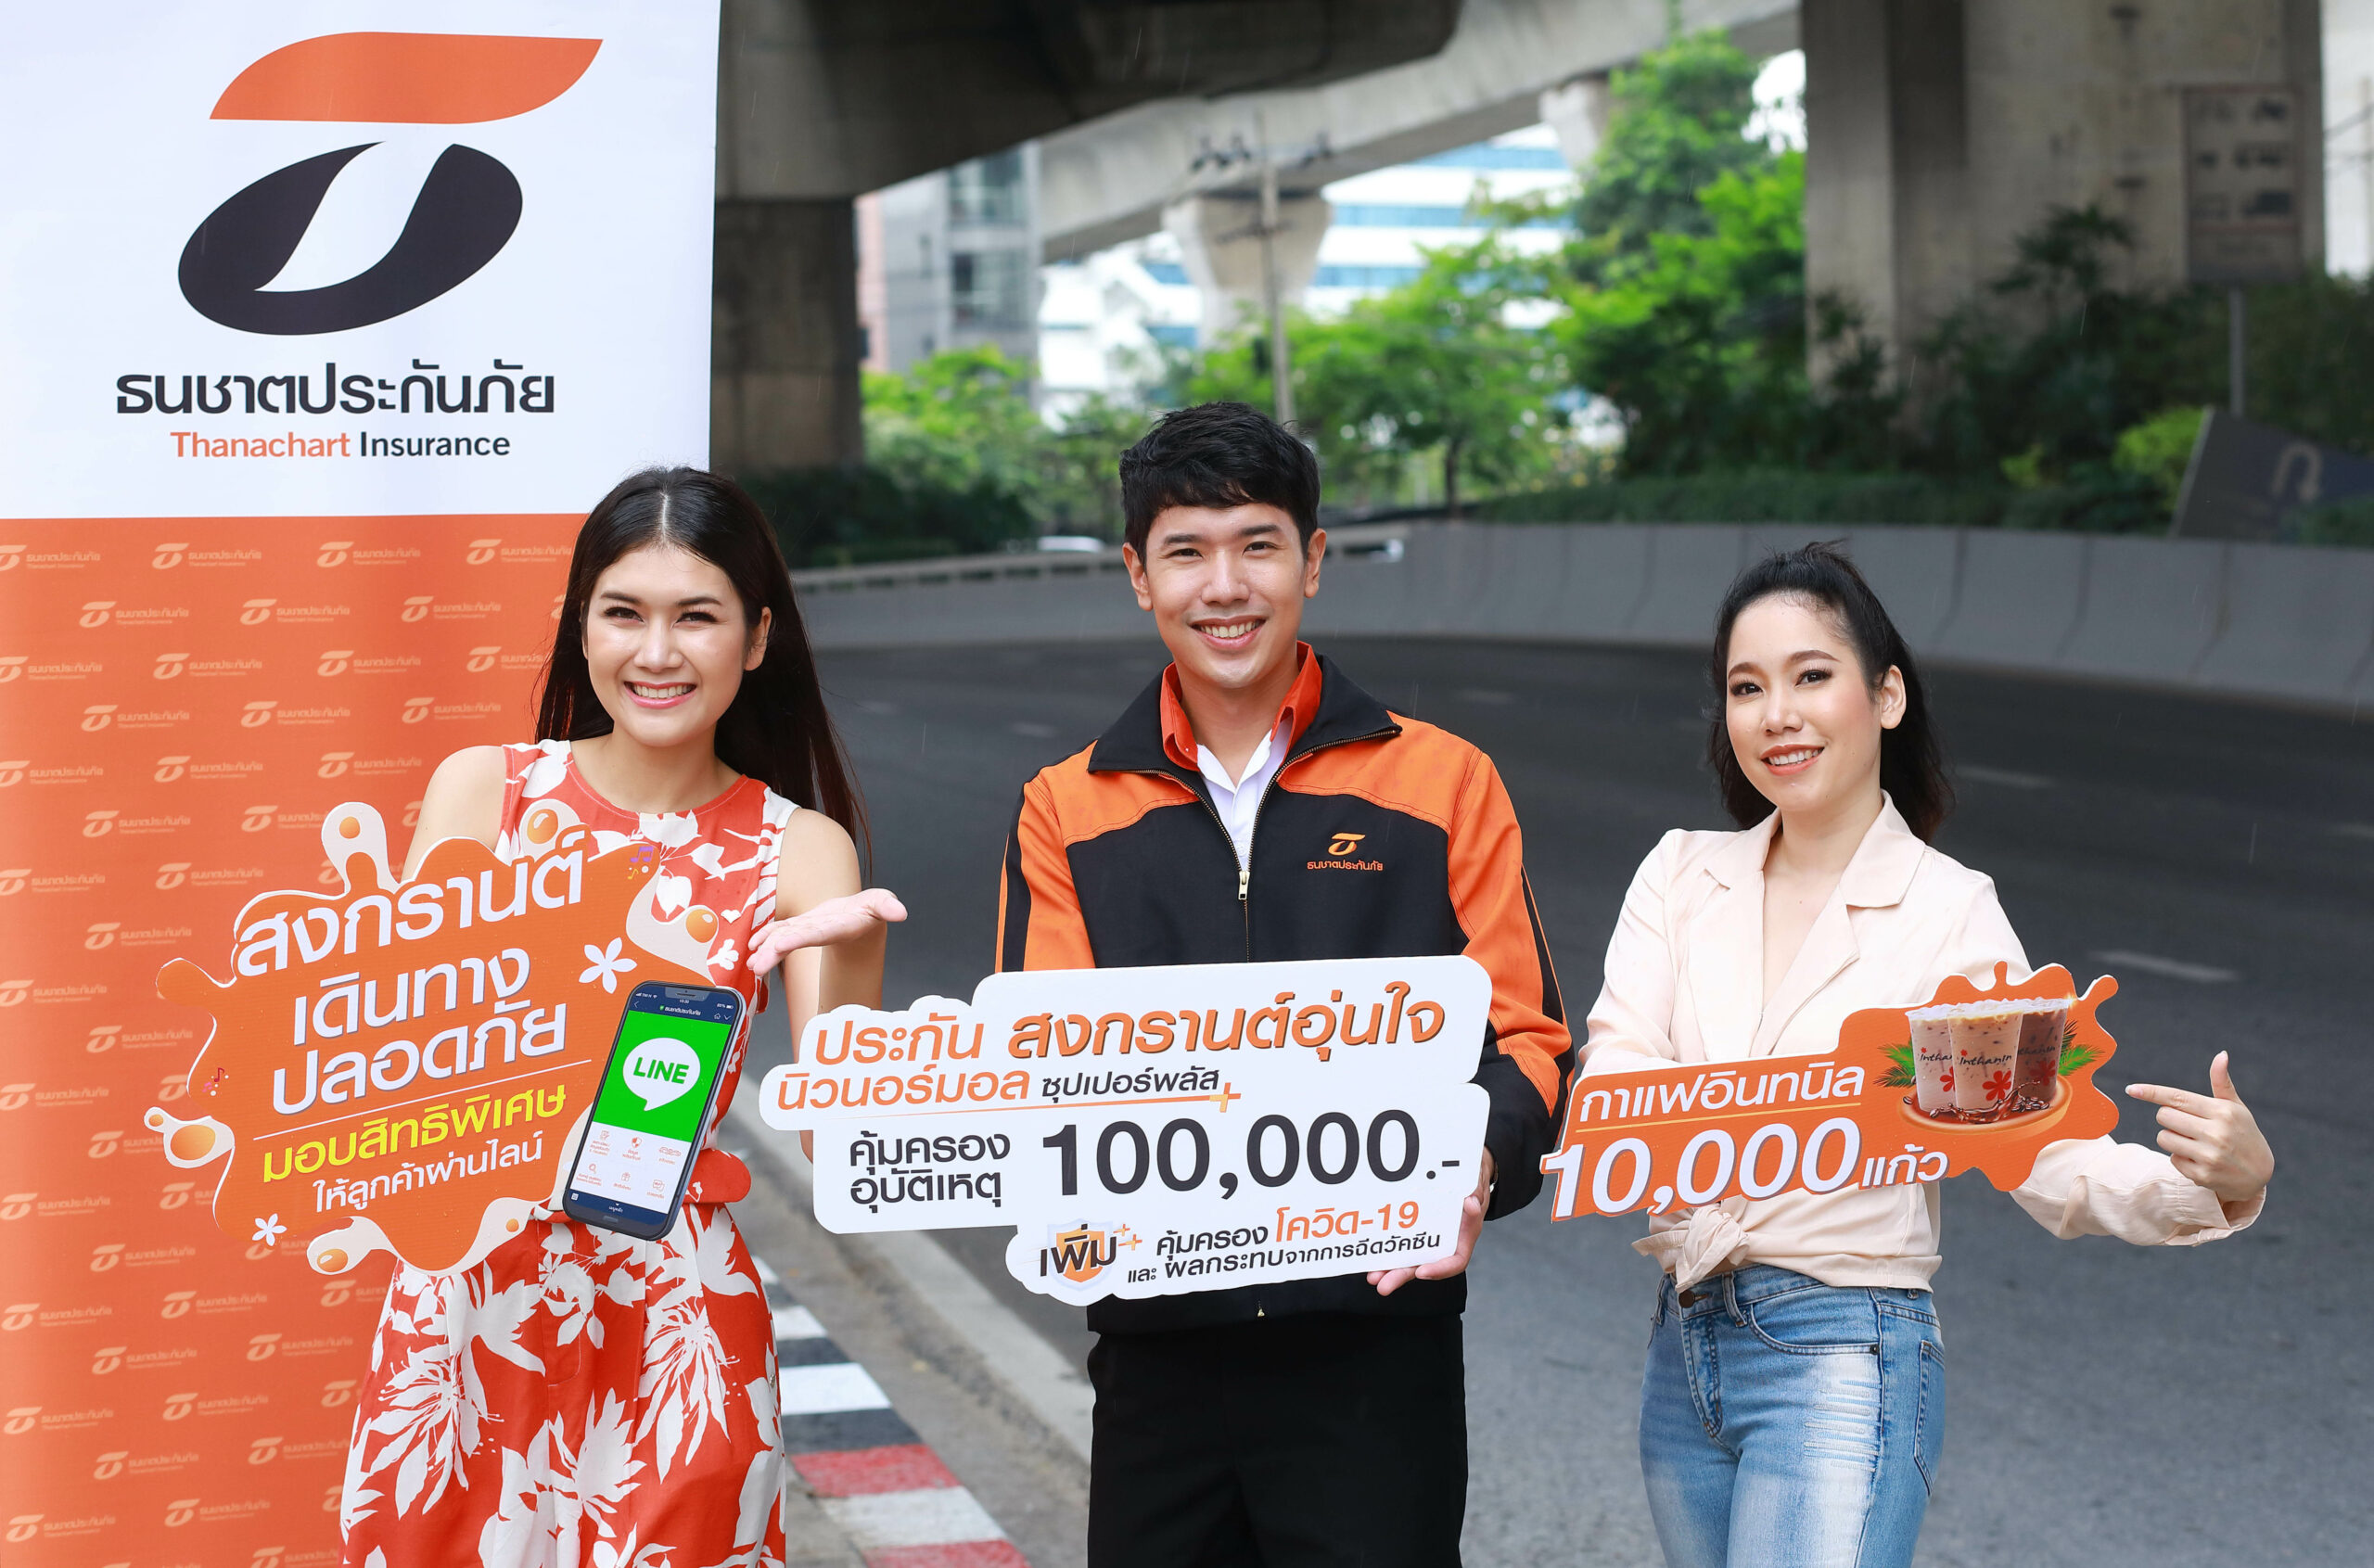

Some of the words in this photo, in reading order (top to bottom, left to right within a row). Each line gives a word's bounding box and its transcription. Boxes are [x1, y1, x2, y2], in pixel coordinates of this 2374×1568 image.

[117, 359, 554, 414] ธนชาตประกันภัย
[171, 432, 349, 457] Thanachart
[362, 432, 509, 456] Insurance
[237, 831, 588, 976] สงกรานต์
[294, 949, 530, 1053] เดินทาง
[816, 1013, 983, 1064] ประกัน
[1009, 981, 1444, 1059] สงกรานต์อุ่นใจ
[274, 1000, 566, 1114] ปลอดภัย
[633, 1056, 689, 1084] LINE
[779, 1064, 1029, 1110] นิวนอร์มอล
[1042, 1065, 1219, 1103] ซุปเปอร์พลัส
[1580, 1062, 1864, 1121] กาแฟอินทนิล
[264, 1085, 566, 1182] มอบสิทธิพิเศษ
[850, 1131, 1010, 1175] คุ้มครอง
[313, 1131, 542, 1212] ให้ลูกค้าผ่านไลน์
[851, 1168, 1001, 1213] อุบัติเหตุ
[1544, 1117, 1861, 1218] 10,000
[1862, 1144, 1947, 1186] แก้ว
[1040, 1224, 1116, 1276] เพิ่ม
[1129, 1268, 1156, 1282] และ
[1166, 1232, 1439, 1278] ผลกระทบจากการฉีดวัคซีน
[1157, 1227, 1268, 1259] คุ้มครอง
[1276, 1202, 1418, 1242] โควิด-19
